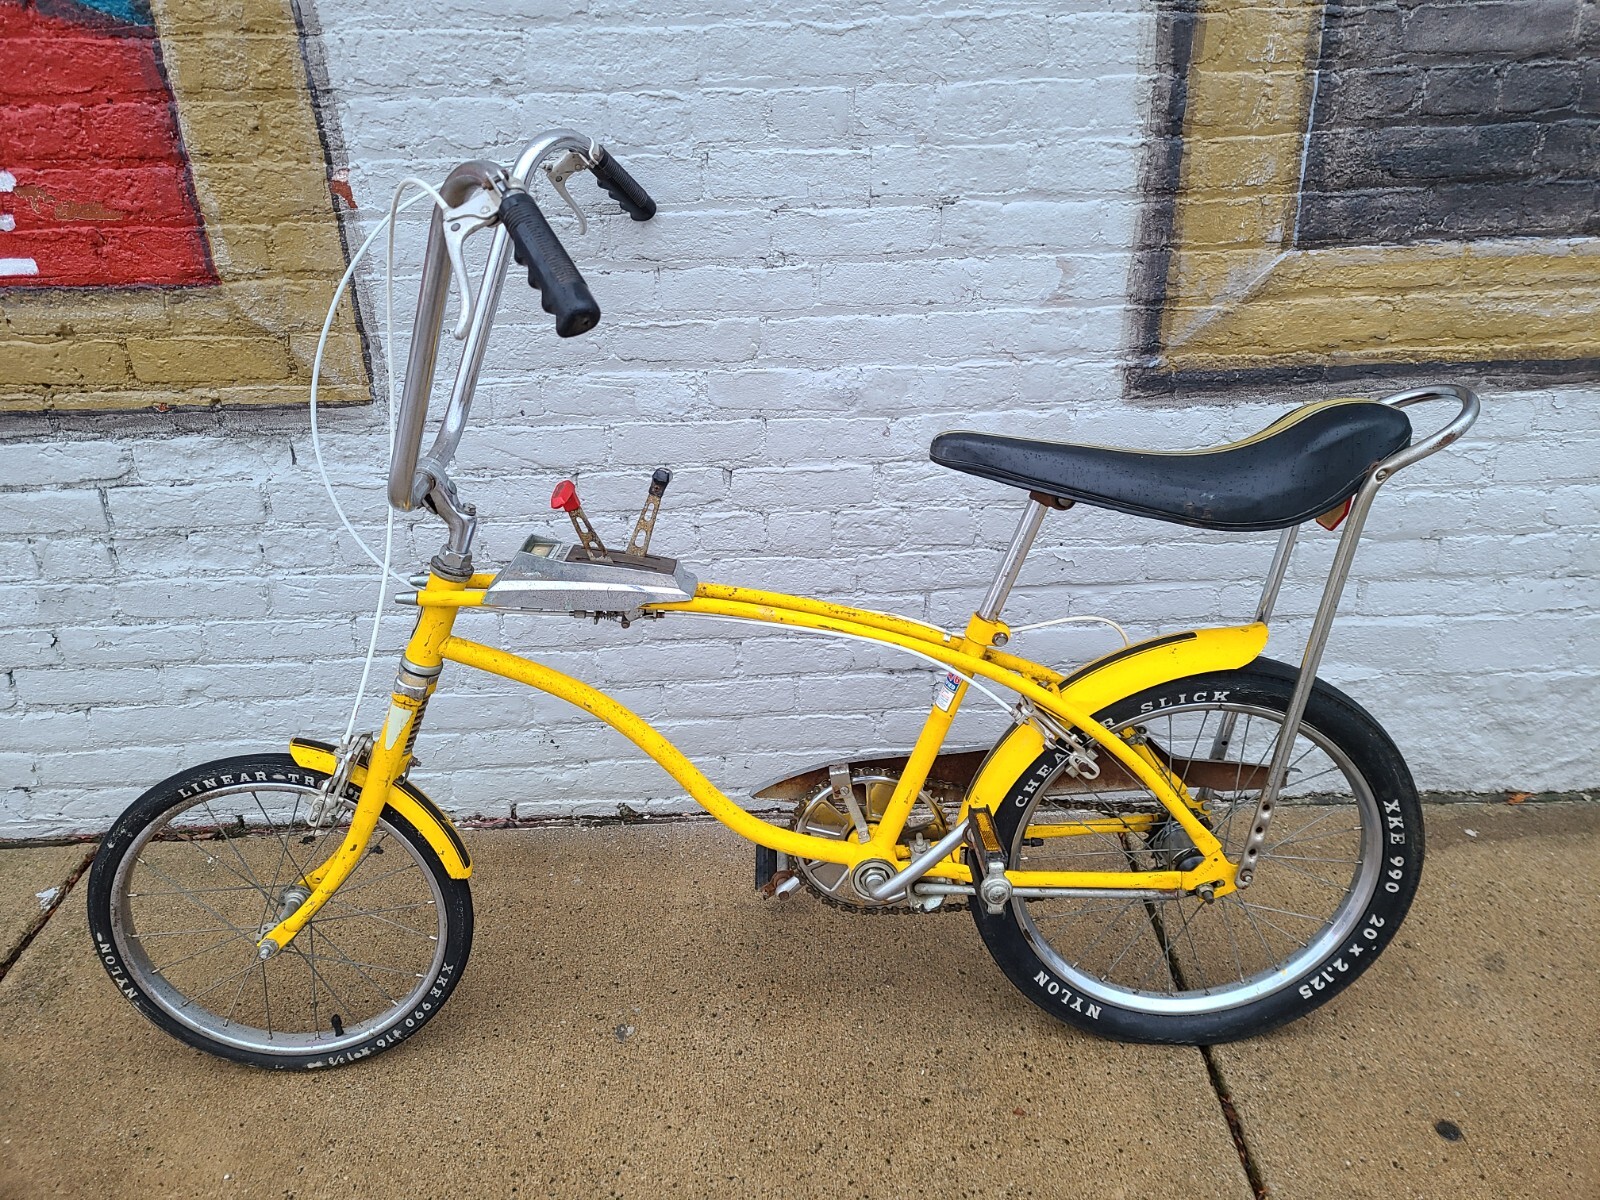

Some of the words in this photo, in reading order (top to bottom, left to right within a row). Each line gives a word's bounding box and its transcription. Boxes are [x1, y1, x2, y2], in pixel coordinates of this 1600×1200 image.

[1015, 717, 1116, 807] CHEAR
[1140, 691, 1231, 713] SLICK
[1383, 799, 1405, 845] XKE
[1385, 856, 1405, 893] 990
[99, 943, 138, 999] NYLON
[430, 962, 454, 998] XKE
[1299, 957, 1349, 999] 2.125
[405, 1002, 432, 1028] 990
[1033, 970, 1102, 1020] NYLON
